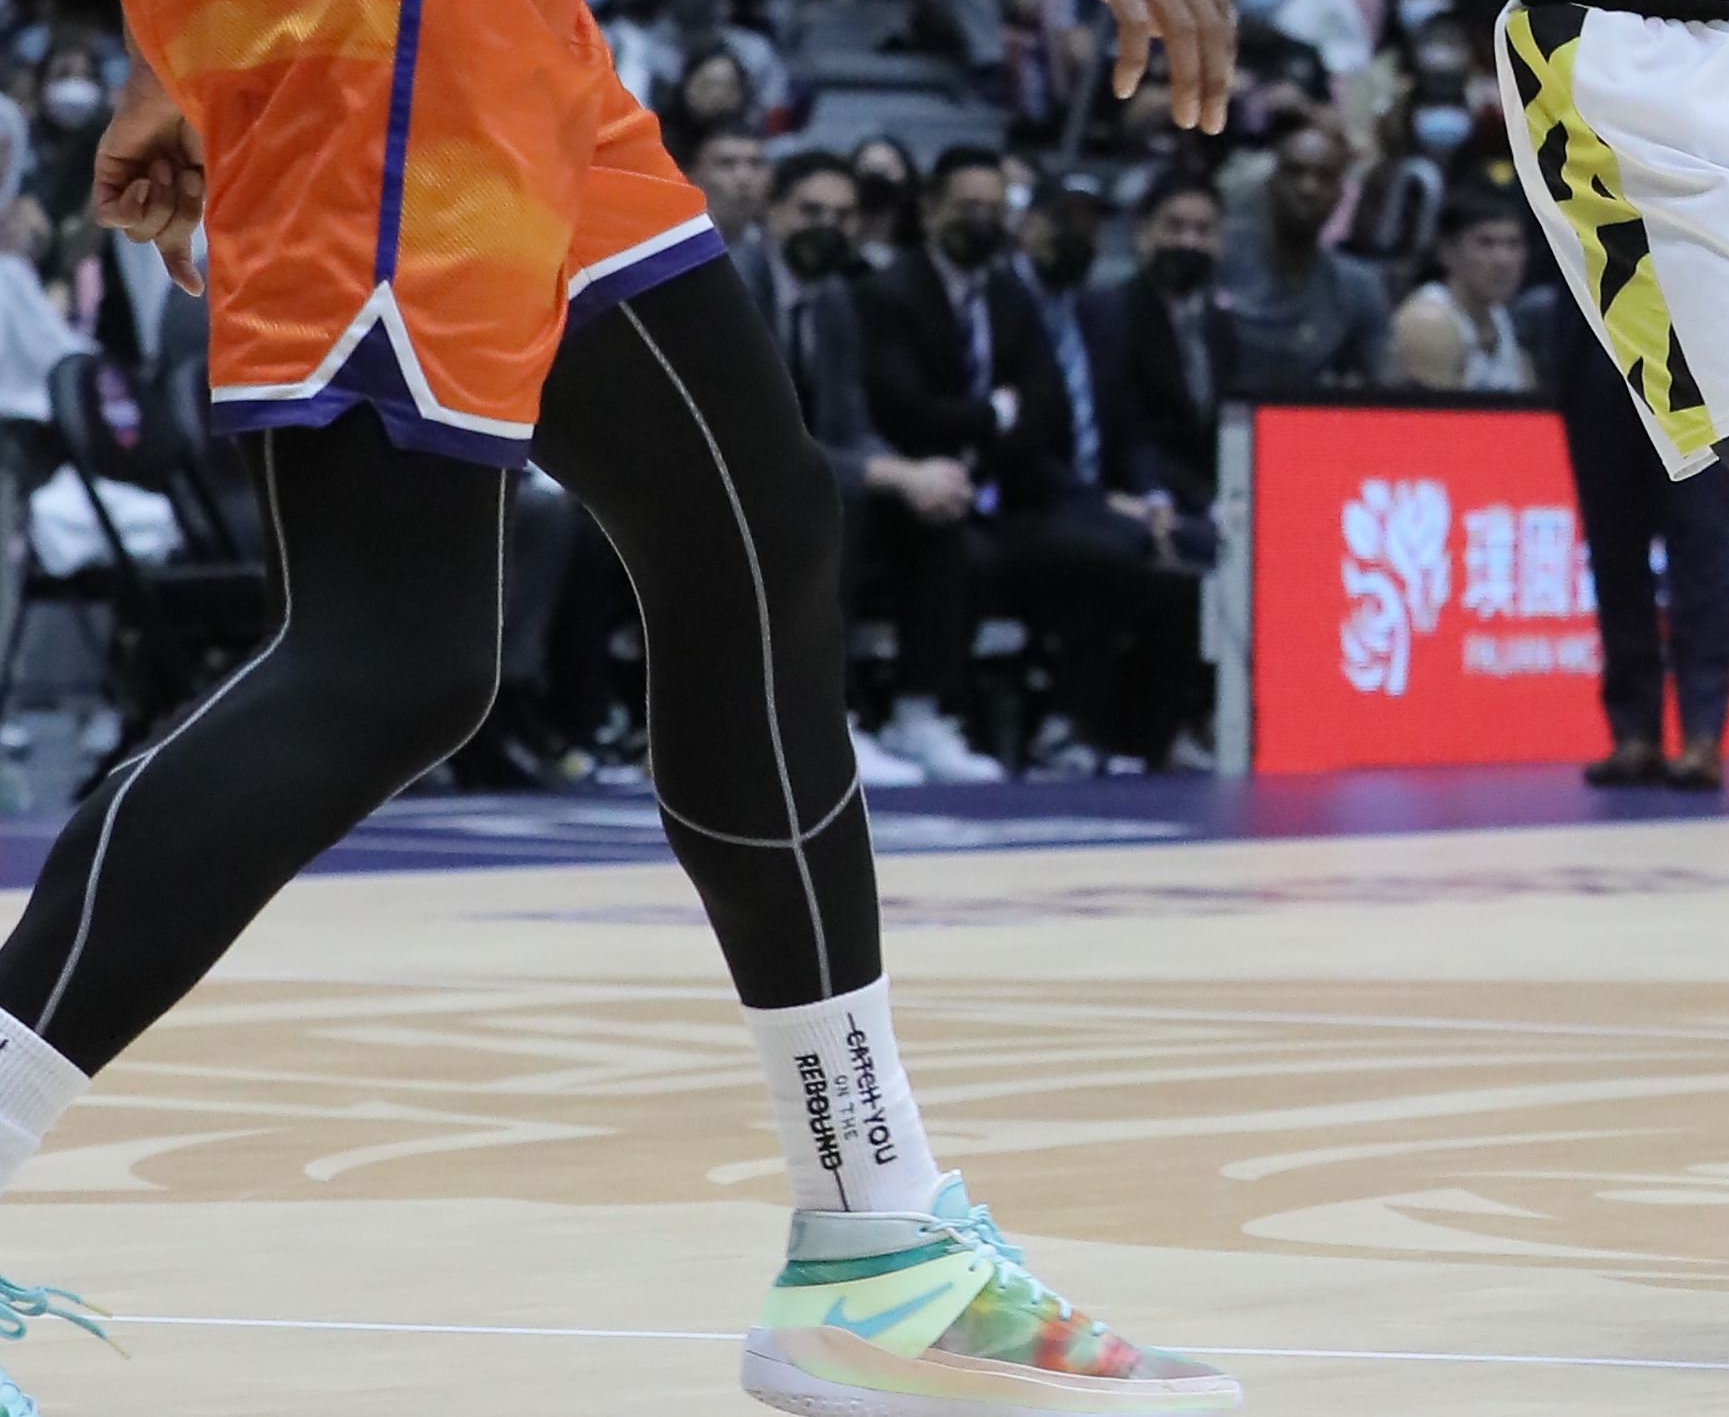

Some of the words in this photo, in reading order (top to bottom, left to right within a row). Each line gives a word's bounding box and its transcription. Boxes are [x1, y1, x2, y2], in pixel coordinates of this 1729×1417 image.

[834, 1074, 851, 1098] ON
[846, 1029, 882, 1106] CATCH
[795, 1052, 843, 1171] REBOUND
[840, 1101, 859, 1141] THE
[863, 1106, 898, 1166] YOU
